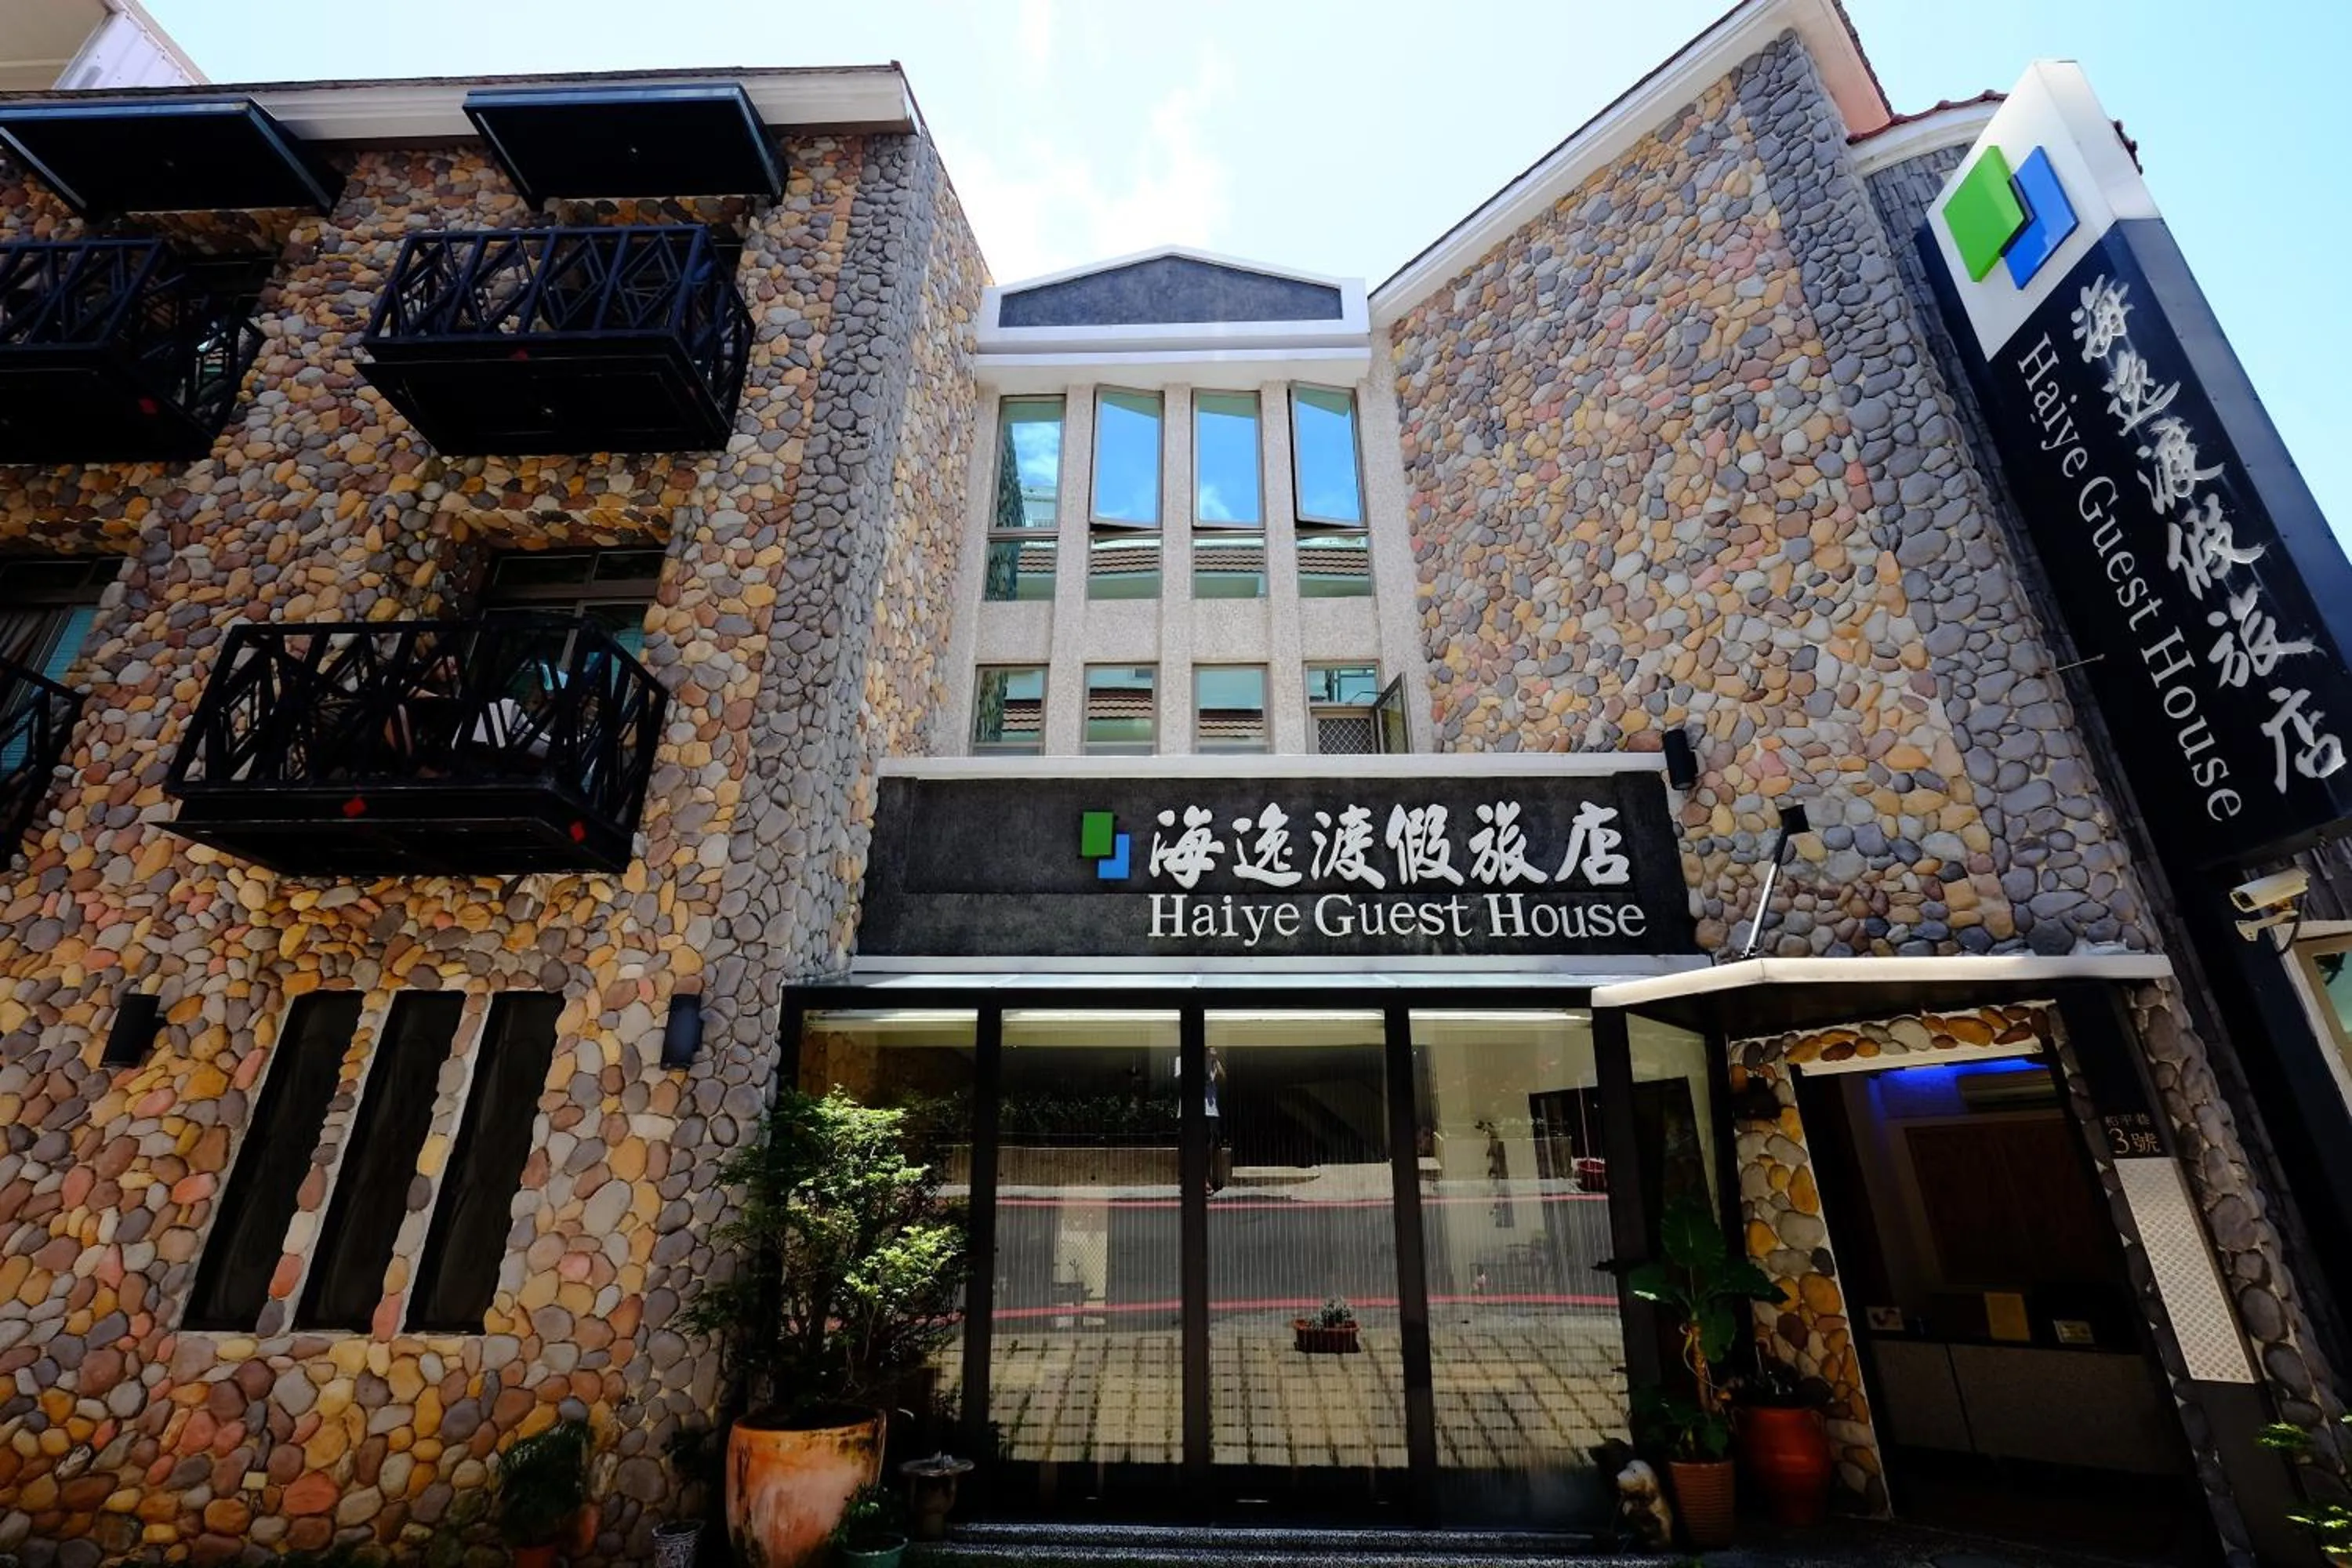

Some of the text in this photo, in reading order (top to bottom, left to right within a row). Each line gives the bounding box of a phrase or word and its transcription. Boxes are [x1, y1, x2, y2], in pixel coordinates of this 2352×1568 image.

[2017, 332, 2242, 822] Haiye Guest House
[2071, 274, 2347, 793] 海逸渡假旅店
[1147, 893, 1646, 946] Haiye Guest House
[1149, 800, 1630, 890] 海逸渡假旅店
